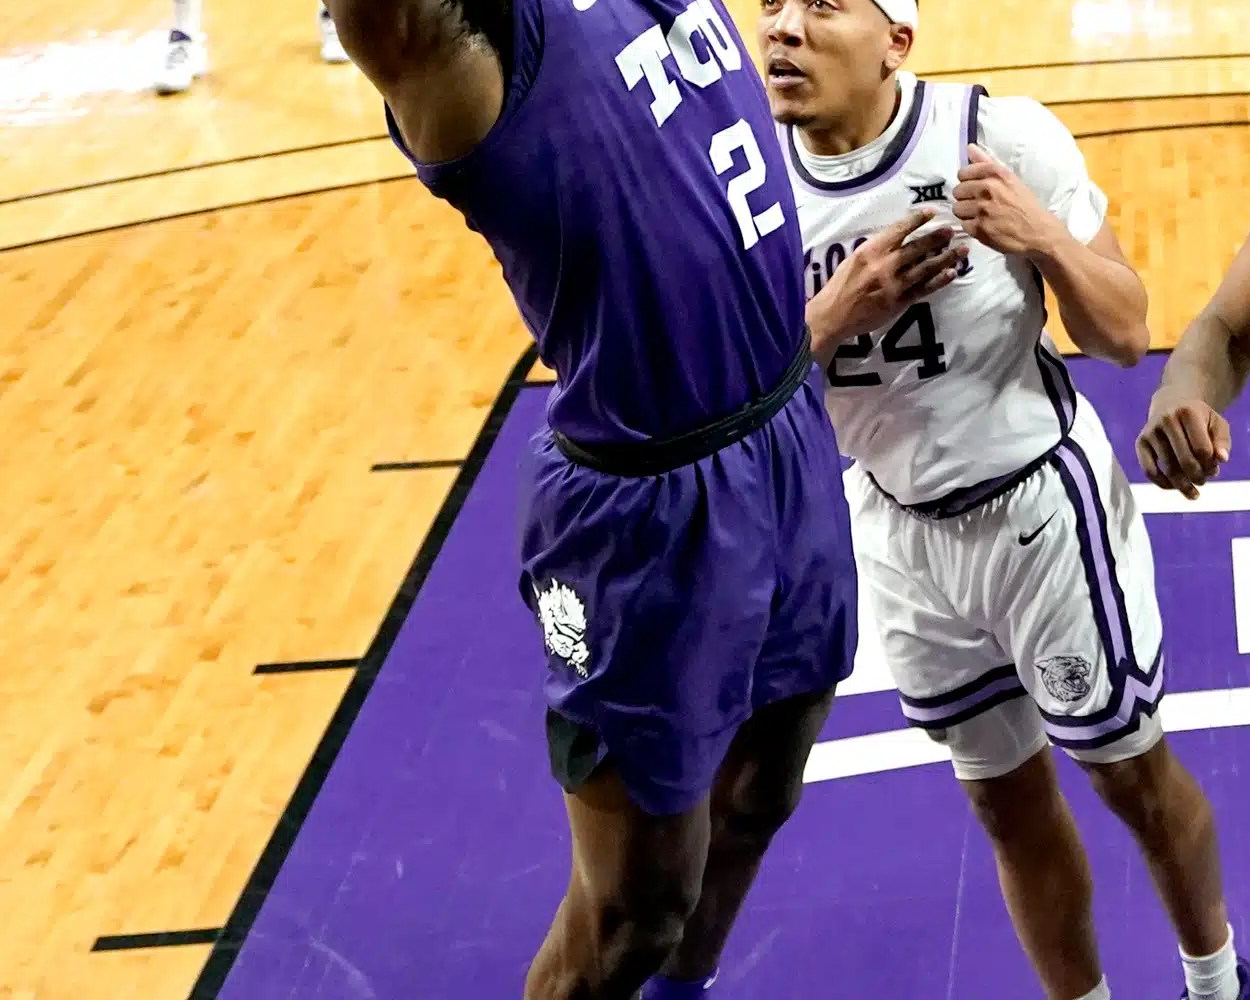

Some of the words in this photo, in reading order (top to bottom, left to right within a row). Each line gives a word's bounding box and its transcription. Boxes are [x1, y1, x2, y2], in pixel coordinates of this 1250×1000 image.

[709, 118, 786, 251] 2
[909, 180, 949, 205] XII
[827, 302, 947, 388] 24
